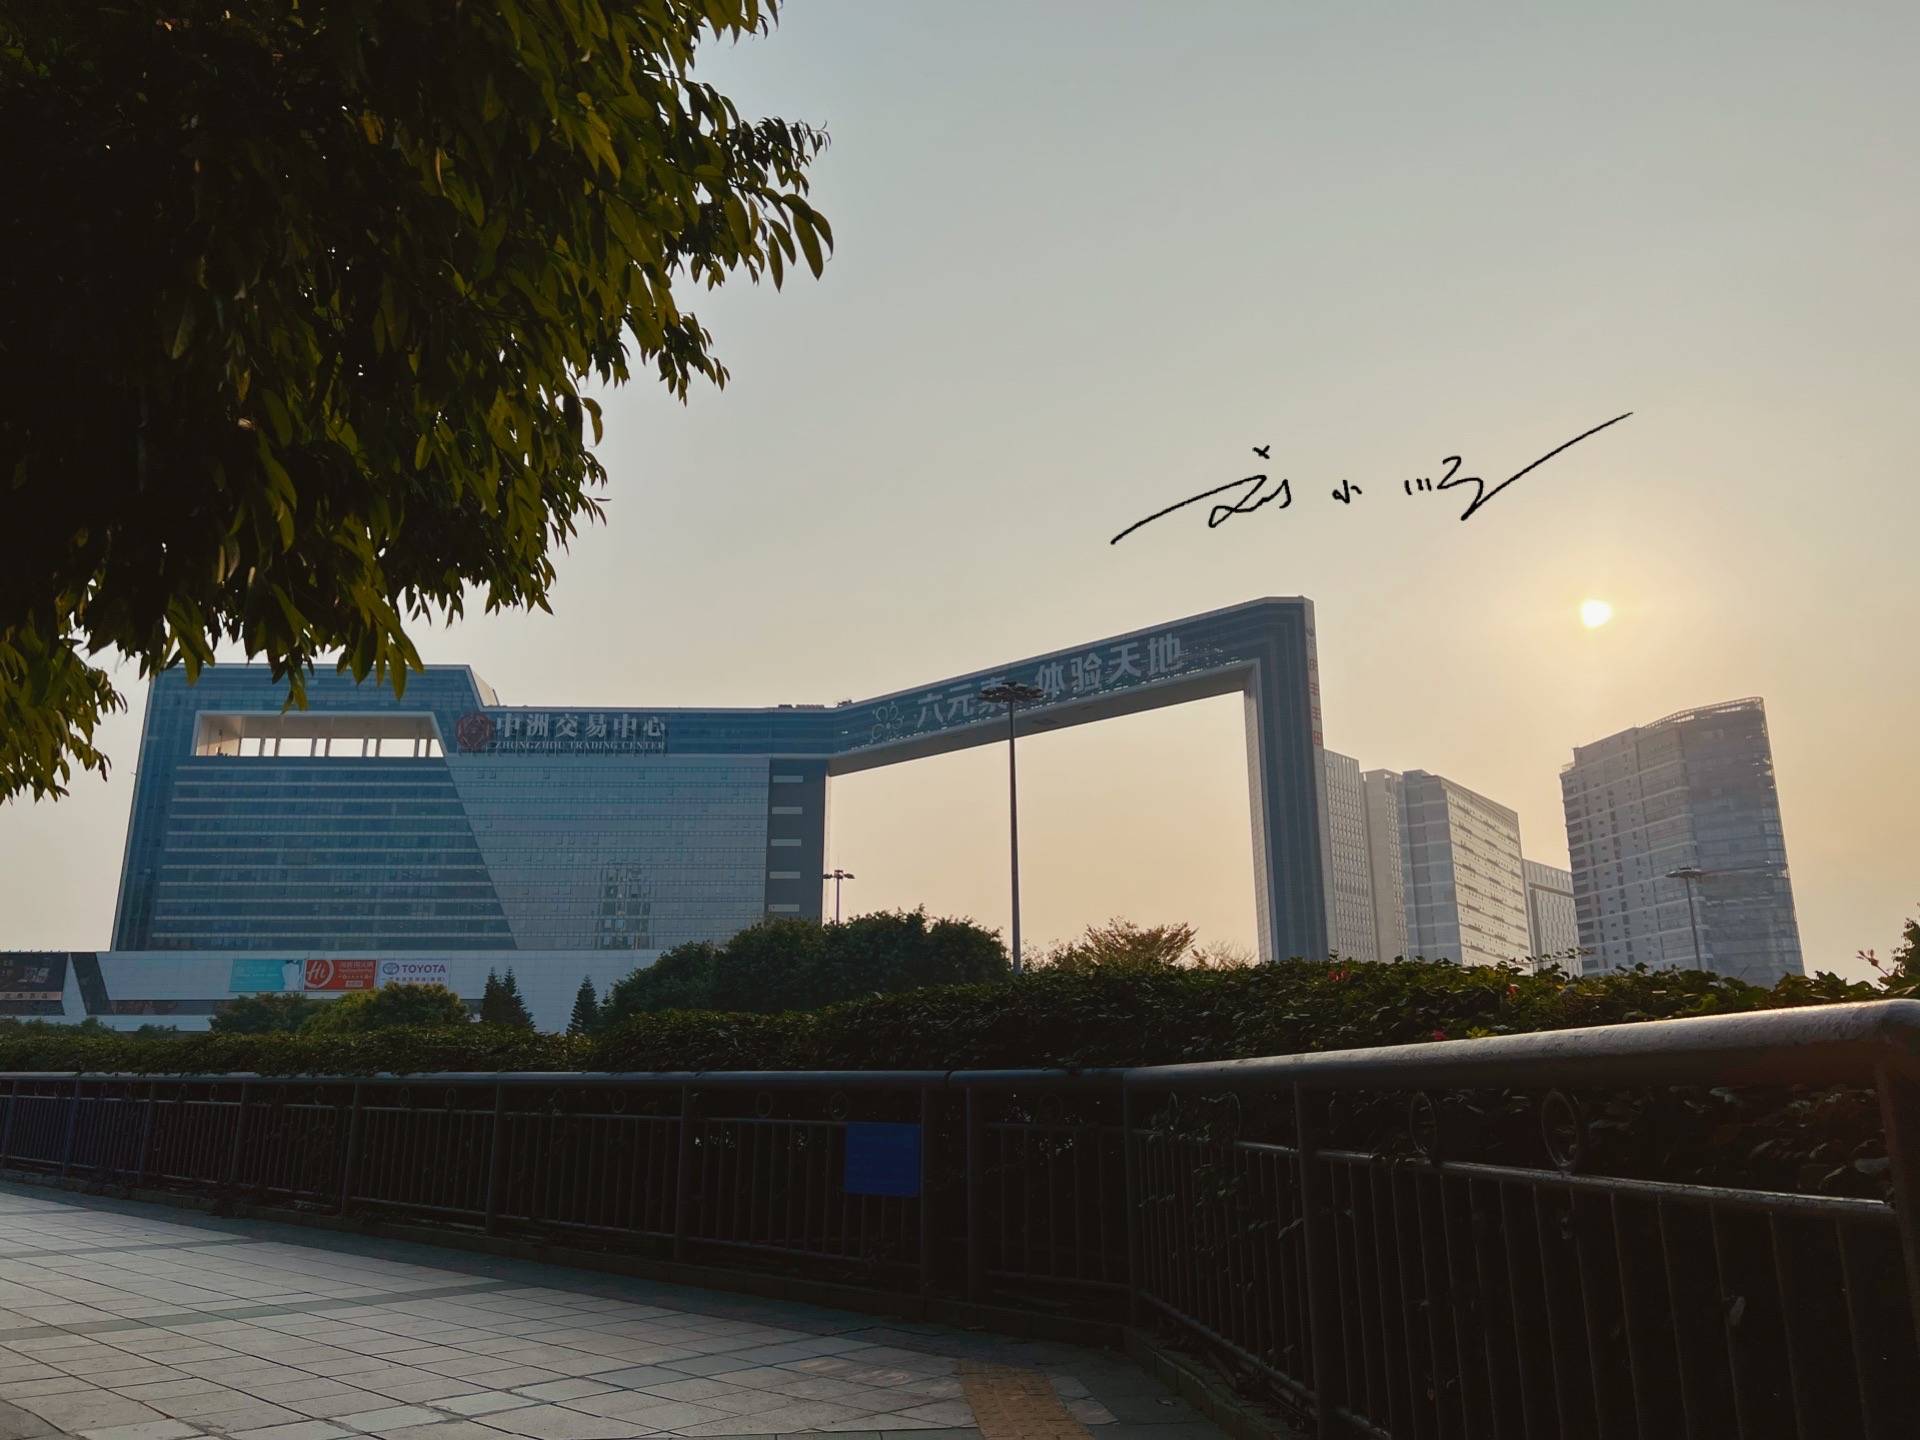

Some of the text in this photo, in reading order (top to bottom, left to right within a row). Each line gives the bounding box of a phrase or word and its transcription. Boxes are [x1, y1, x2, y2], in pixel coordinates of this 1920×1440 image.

[496, 712, 666, 738] 中洲交易中心
[568, 740, 618, 750] TRADING
[622, 740, 665, 750] CENTER
[402, 964, 446, 974] TOYOTA
